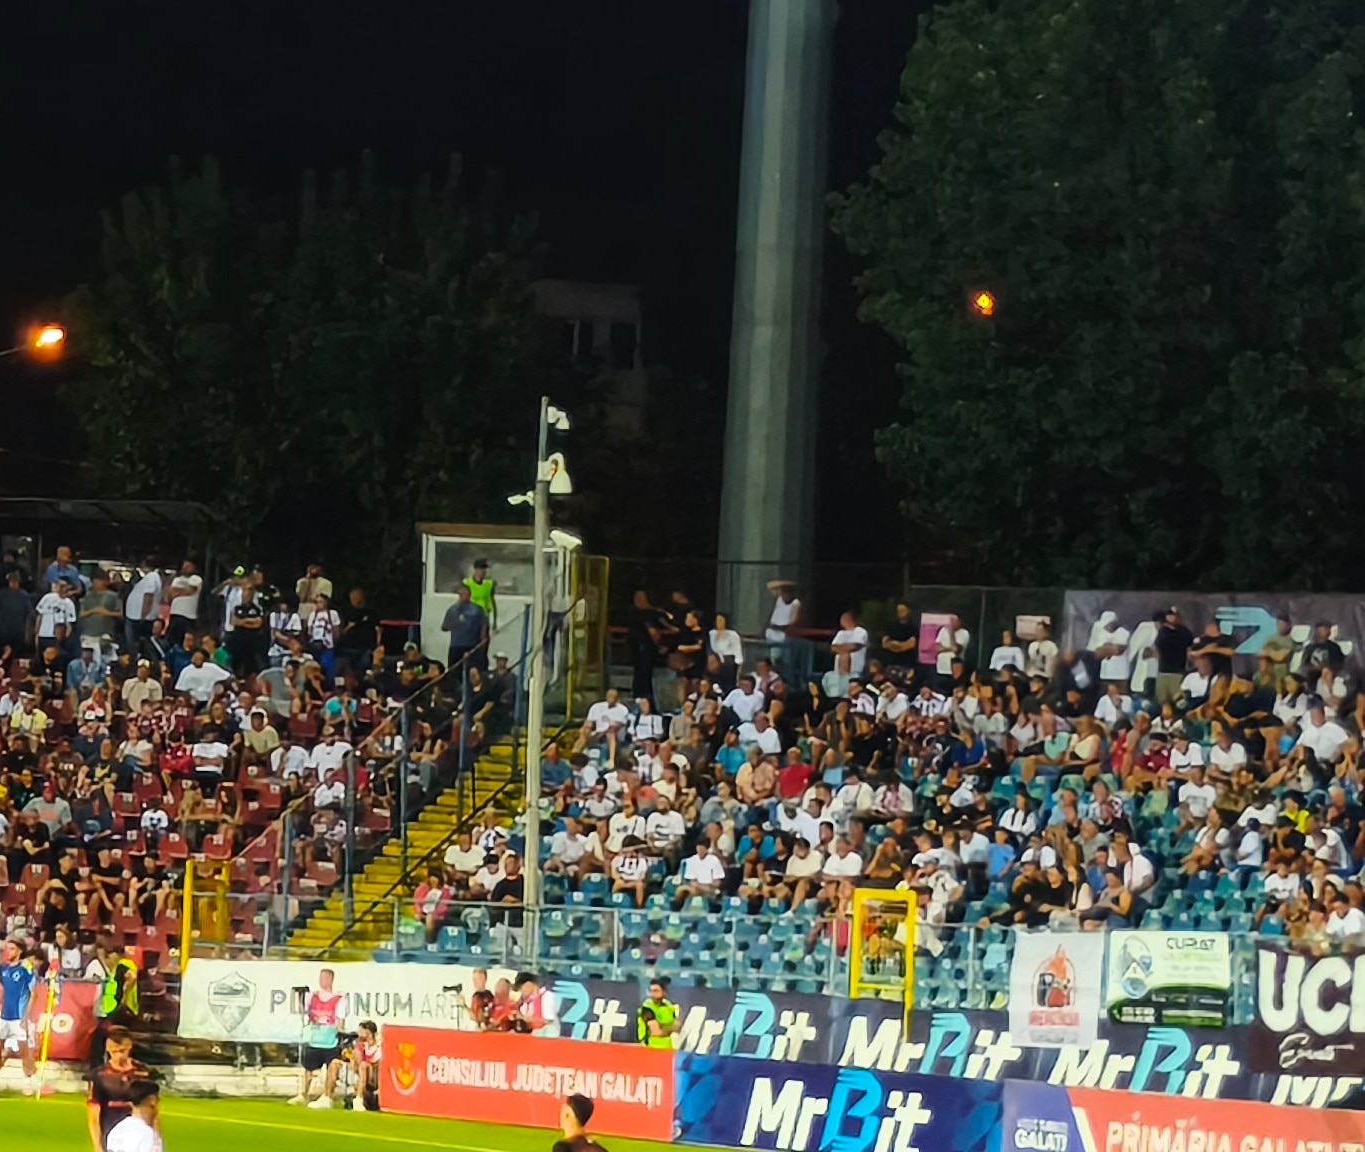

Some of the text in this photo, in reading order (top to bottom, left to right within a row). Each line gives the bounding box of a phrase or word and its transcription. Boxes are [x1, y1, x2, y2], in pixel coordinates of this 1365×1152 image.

[1258, 949, 1365, 1036] UC
[426, 1054, 510, 1091] CONSILIUL
[601, 1070, 663, 1110] GALAȚI
